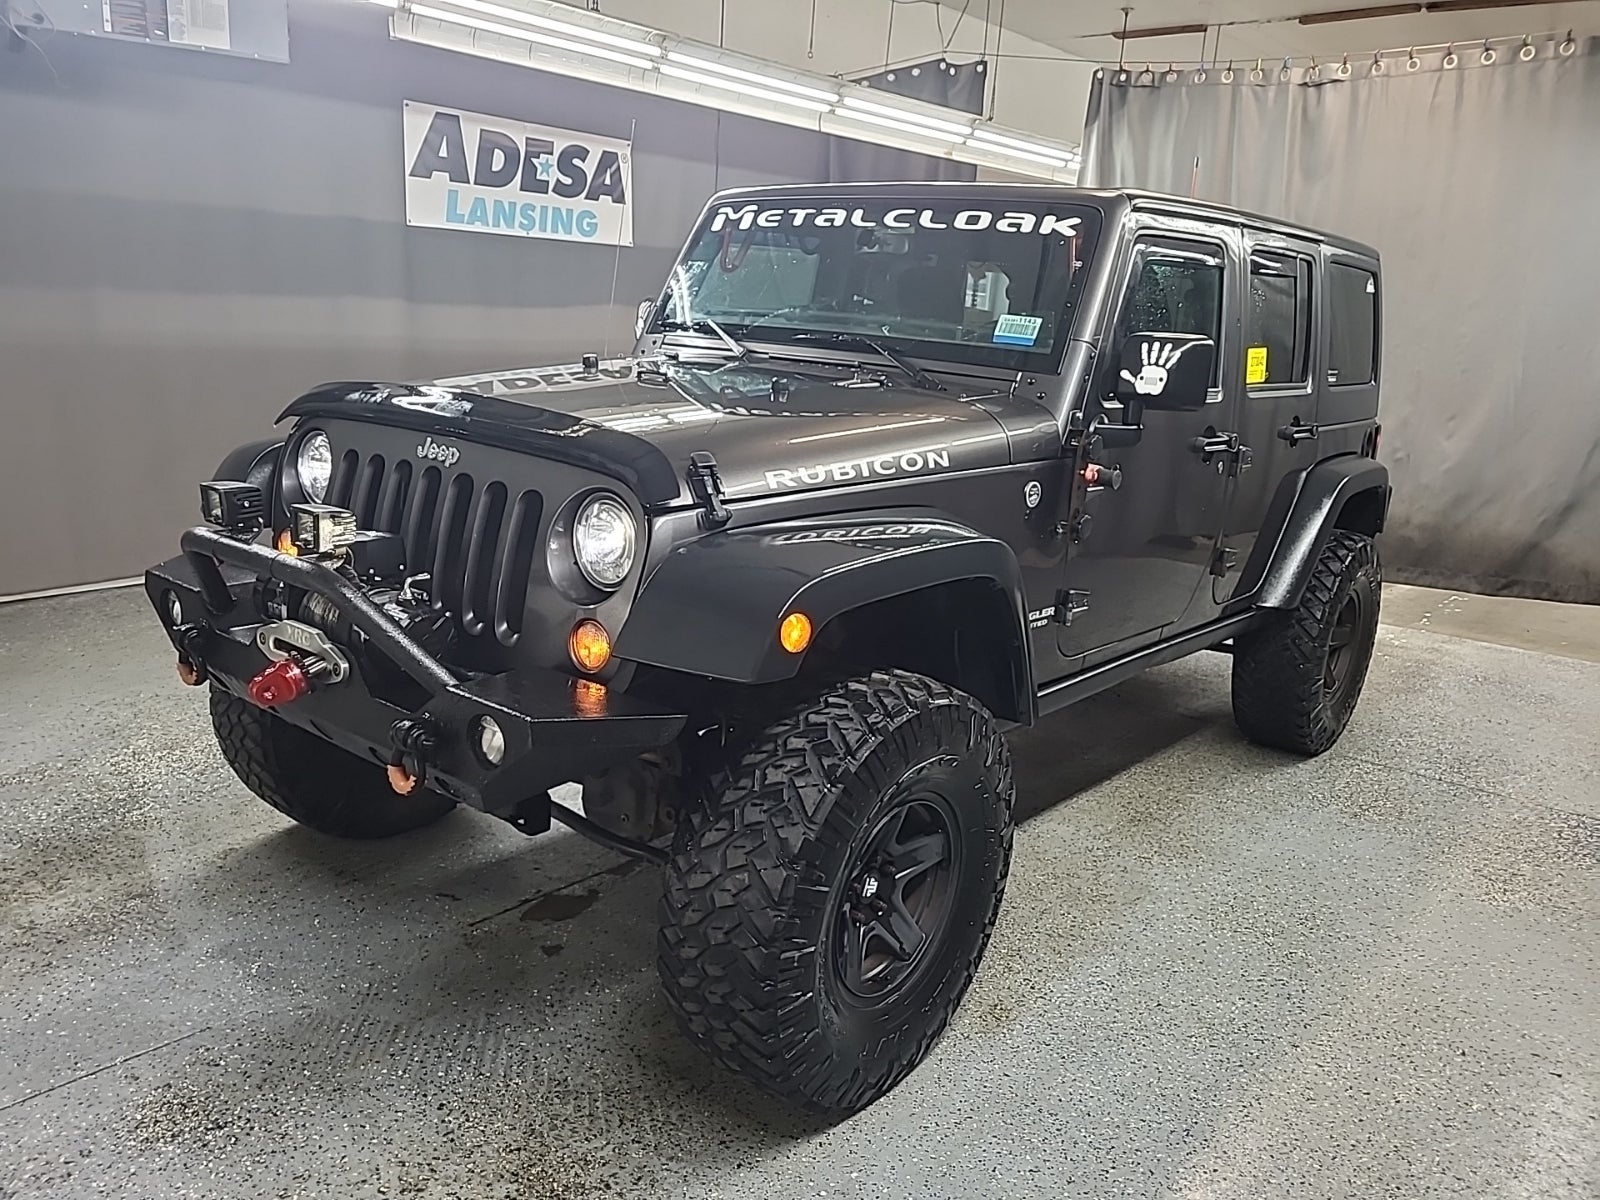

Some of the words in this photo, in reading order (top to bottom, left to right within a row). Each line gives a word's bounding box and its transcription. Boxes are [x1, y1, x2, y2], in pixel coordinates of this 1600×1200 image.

[409, 111, 627, 205] ADESA
[446, 188, 599, 238] LANSING
[416, 436, 460, 468] Jeep
[764, 449, 951, 490] RUBICON
